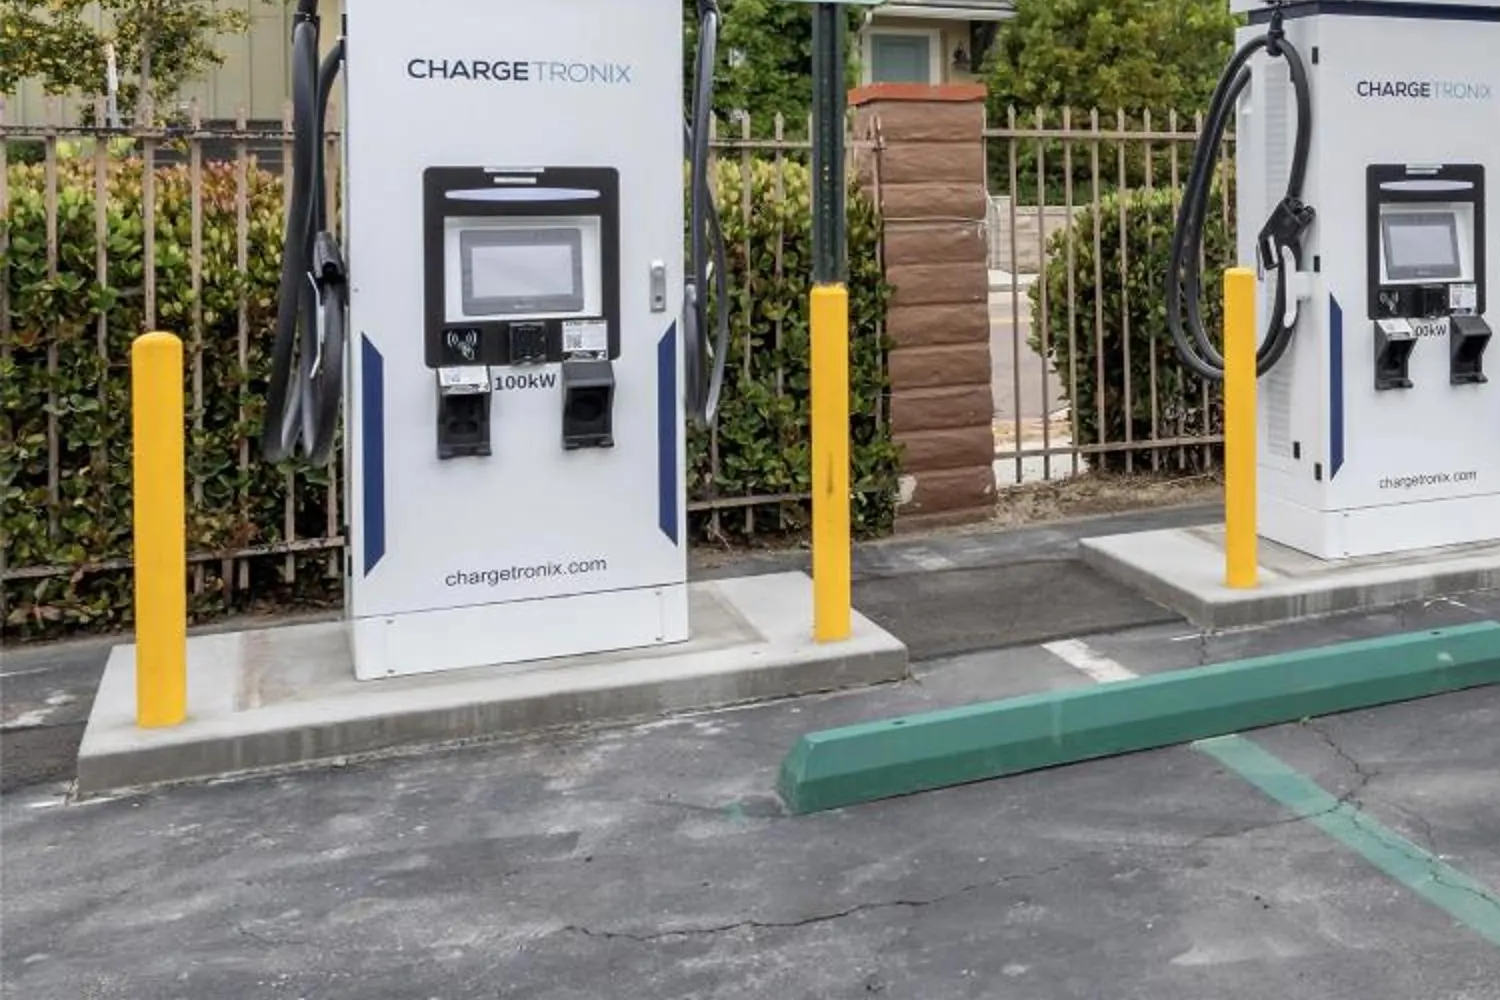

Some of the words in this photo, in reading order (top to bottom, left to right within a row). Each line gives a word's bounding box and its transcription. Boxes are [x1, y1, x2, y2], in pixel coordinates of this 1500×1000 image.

[407, 57, 632, 84] CHARGETRONIX
[494, 373, 557, 391] 100kW
[445, 558, 607, 587] chargetronix.com
